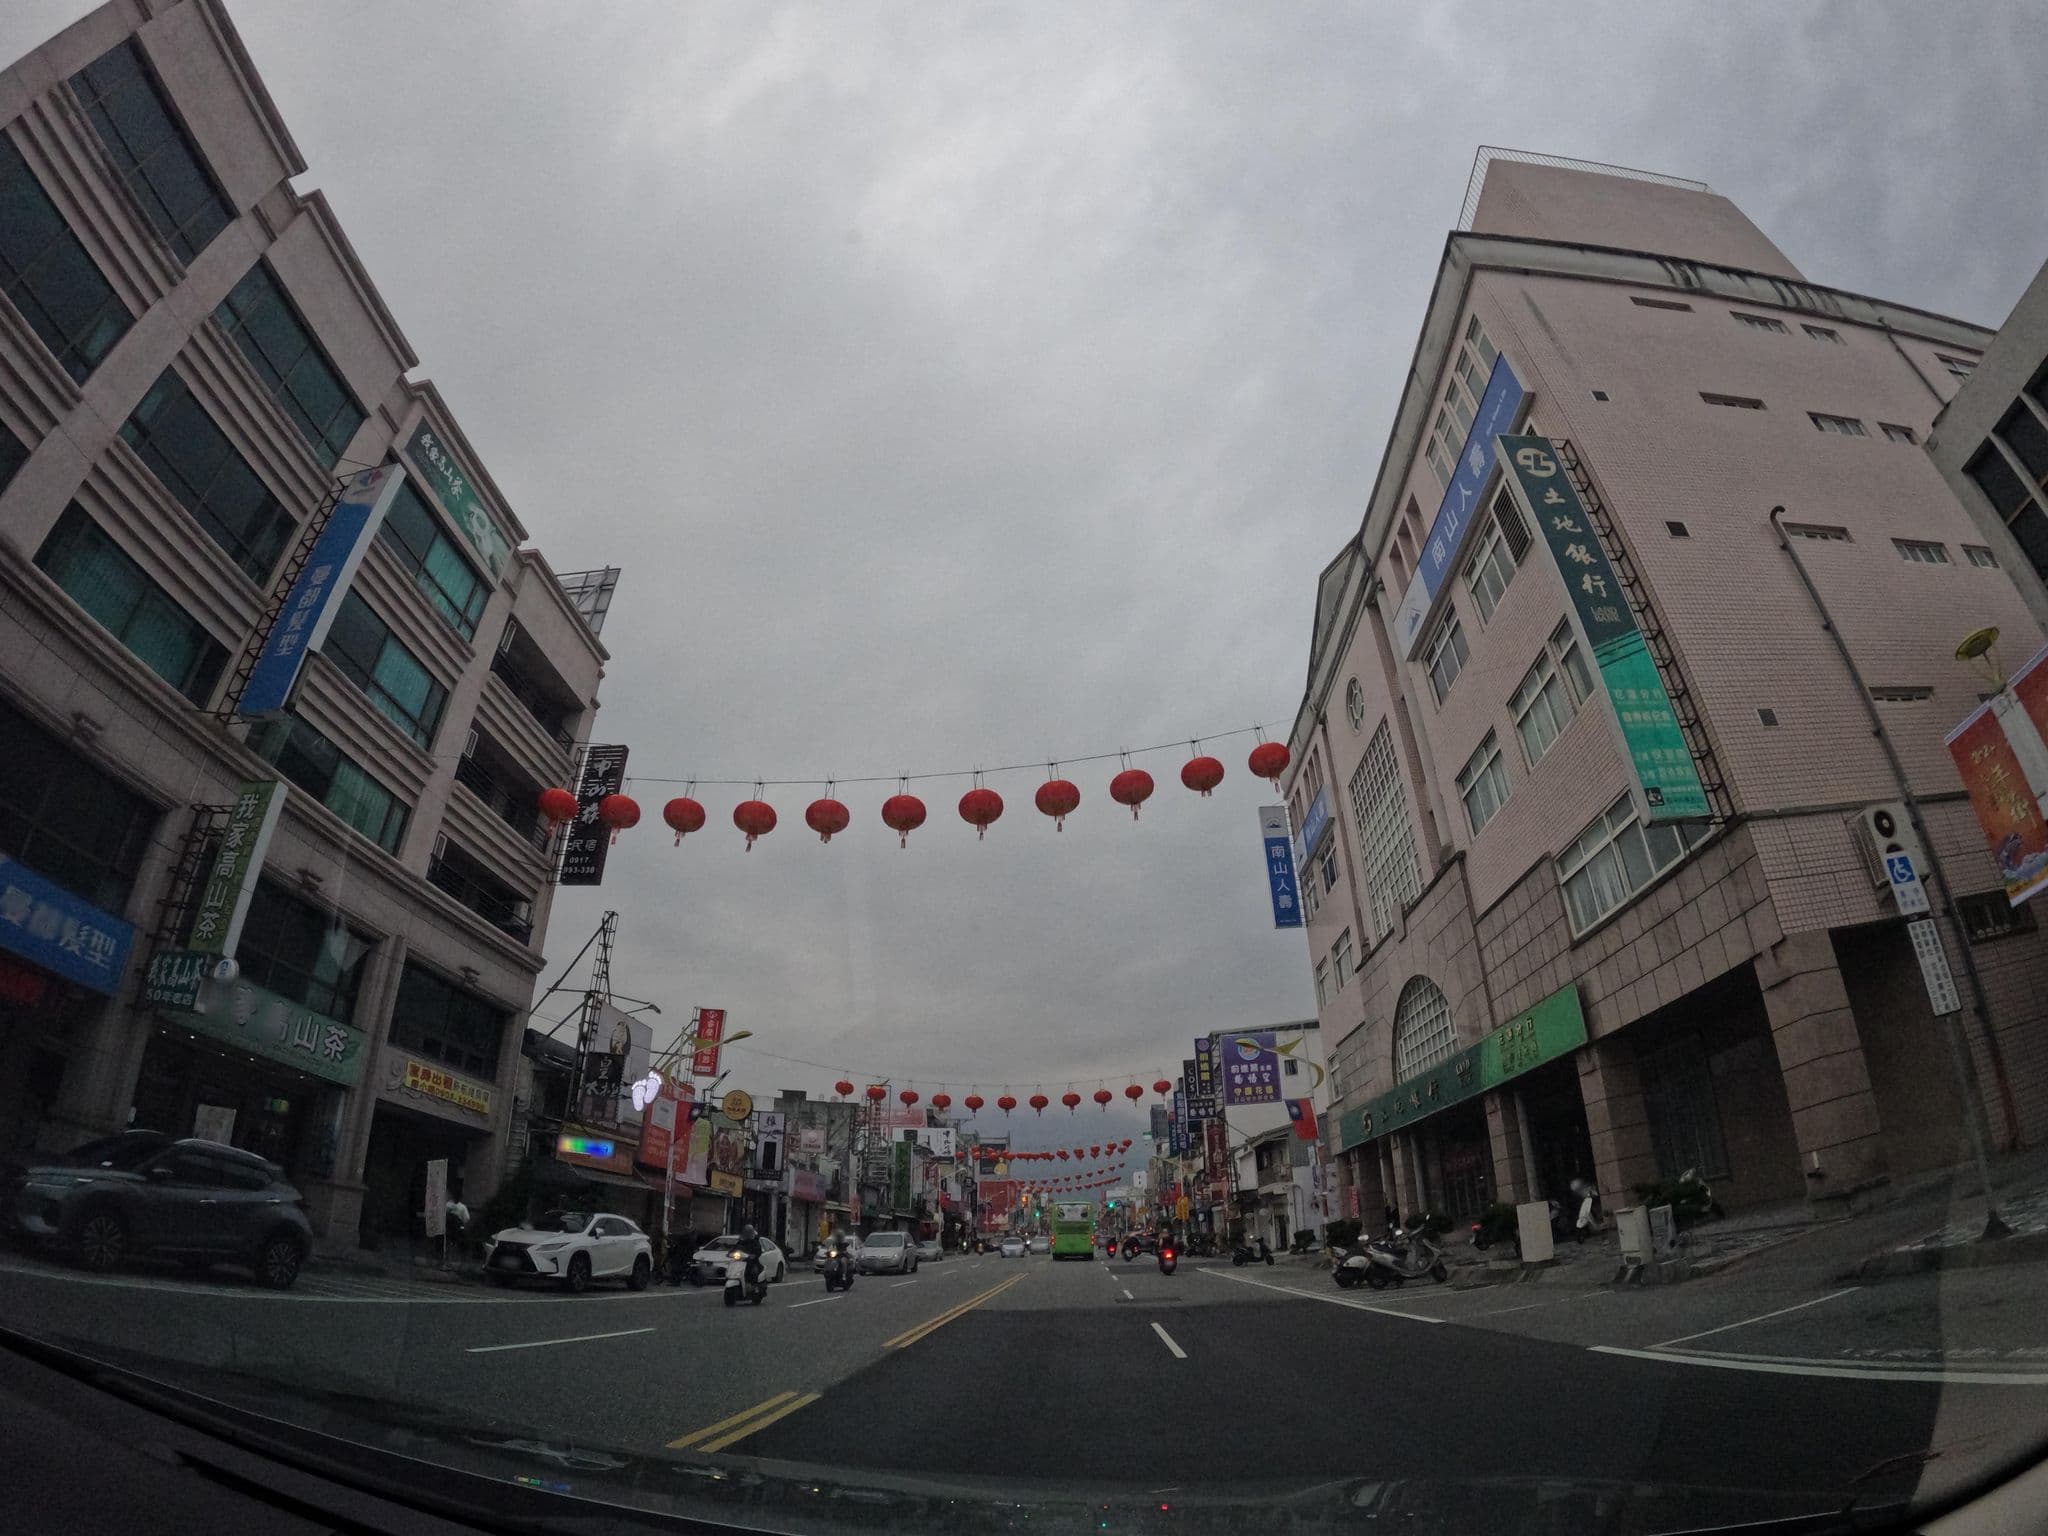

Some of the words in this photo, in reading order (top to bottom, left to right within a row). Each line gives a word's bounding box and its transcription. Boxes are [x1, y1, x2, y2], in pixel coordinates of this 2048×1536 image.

[1431, 440, 1485, 570] 南山人壽
[1543, 487, 1607, 598] 土地銀行
[196, 793, 260, 940] 我家高山茶
[571, 839, 598, 852] 民宿
[1271, 845, 1293, 909] 南山人壽
